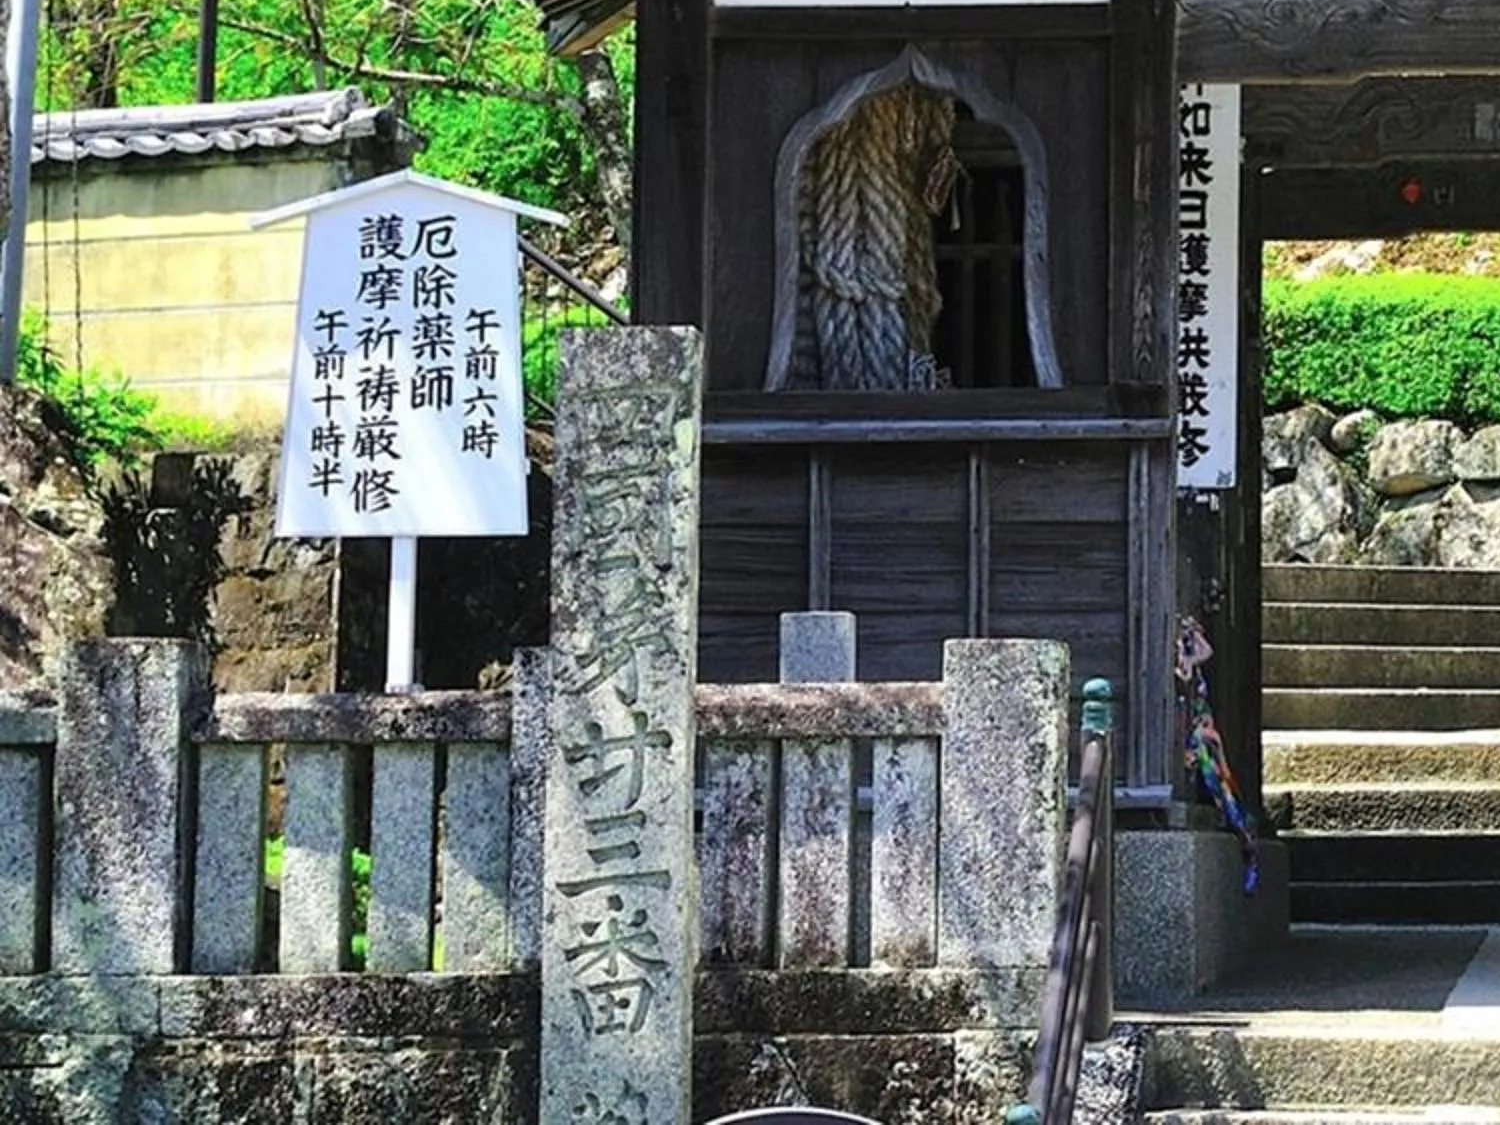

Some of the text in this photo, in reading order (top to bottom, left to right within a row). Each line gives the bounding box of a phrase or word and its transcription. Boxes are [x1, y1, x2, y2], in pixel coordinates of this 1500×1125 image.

[309, 309, 349, 497] 午前十時半
[410, 215, 457, 411] 厄除薬師
[461, 308, 500, 460] 午前六時
